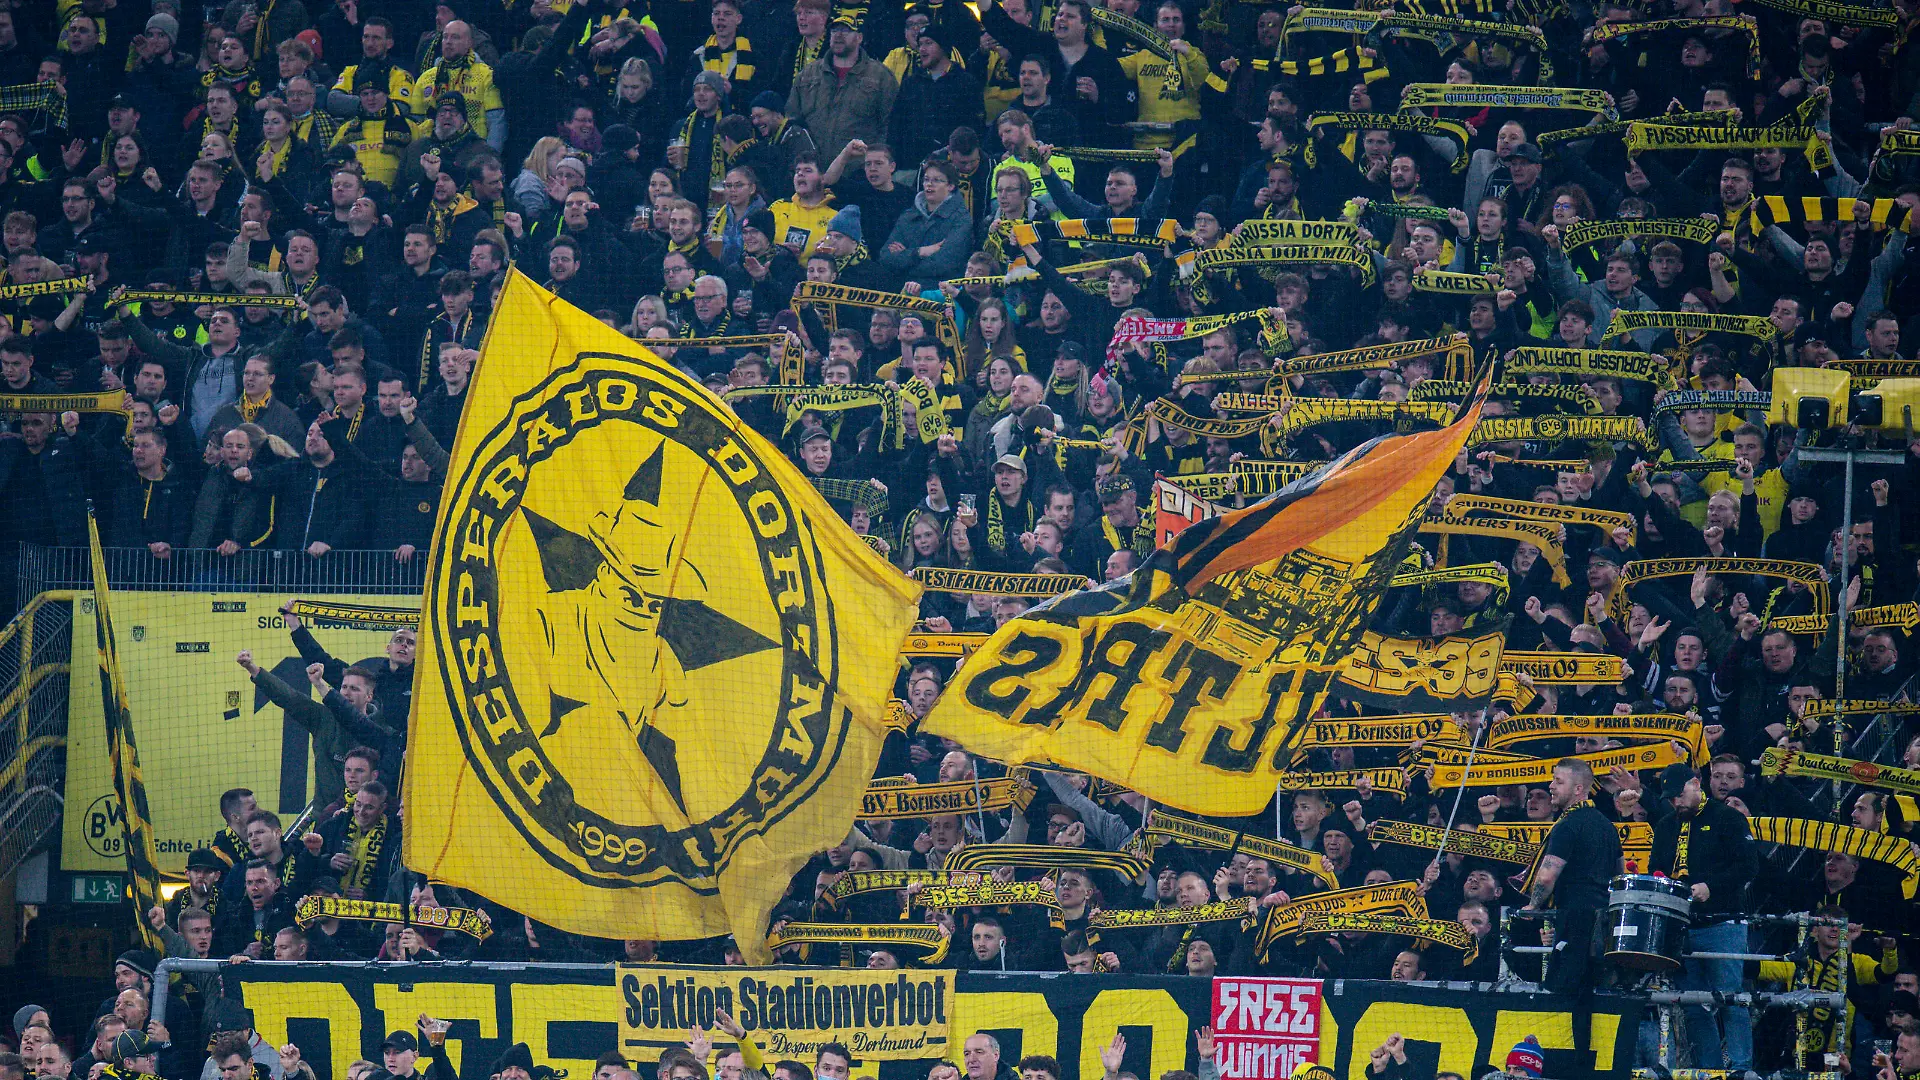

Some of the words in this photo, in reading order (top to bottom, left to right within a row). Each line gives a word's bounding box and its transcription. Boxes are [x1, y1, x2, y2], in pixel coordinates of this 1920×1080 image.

[1816, 4, 1899, 23] DORTMUND
[1562, 224, 1629, 249] DEUTSCHER
[1634, 223, 1687, 237] MEISTER
[1271, 247, 1369, 268] DORTMUND
[810, 285, 844, 298] 1974
[847, 290, 879, 303] UND
[1514, 349, 1581, 367] DORTMUND
[1588, 351, 1651, 374] BORUSSIA
[1708, 391, 1736, 402] MEIN
[1542, 419, 1561, 431] BVB
[1456, 501, 1575, 519] SUPPORTERS
[1423, 515, 1510, 530] PPORTERS
[1514, 522, 1561, 549] WERNE
[1500, 659, 1550, 678] orussia
[1552, 658, 1579, 679] 09
[1346, 721, 1412, 741] Borussia
[1415, 719, 1443, 738] 09
[1493, 717, 1559, 738] BORUSSIA
[1632, 717, 1692, 733] SIEMPRE
[1486, 767, 1547, 779] BORUSSIA
[1798, 753, 1851, 775] Deutscher
[896, 790, 962, 813] Borussia
[965, 785, 992, 805] 09
[932, 888, 970, 905] DES
[1272, 897, 1347, 929] DESPERADOS
[1370, 885, 1425, 917] DORTMUND
[1327, 914, 1371, 929] DES
[622, 973, 734, 1030] Sektion
[739, 973, 947, 1031] Stadionverbot
[1217, 982, 1316, 1034] FREE
[851, 1032, 926, 1052] Dortmund
